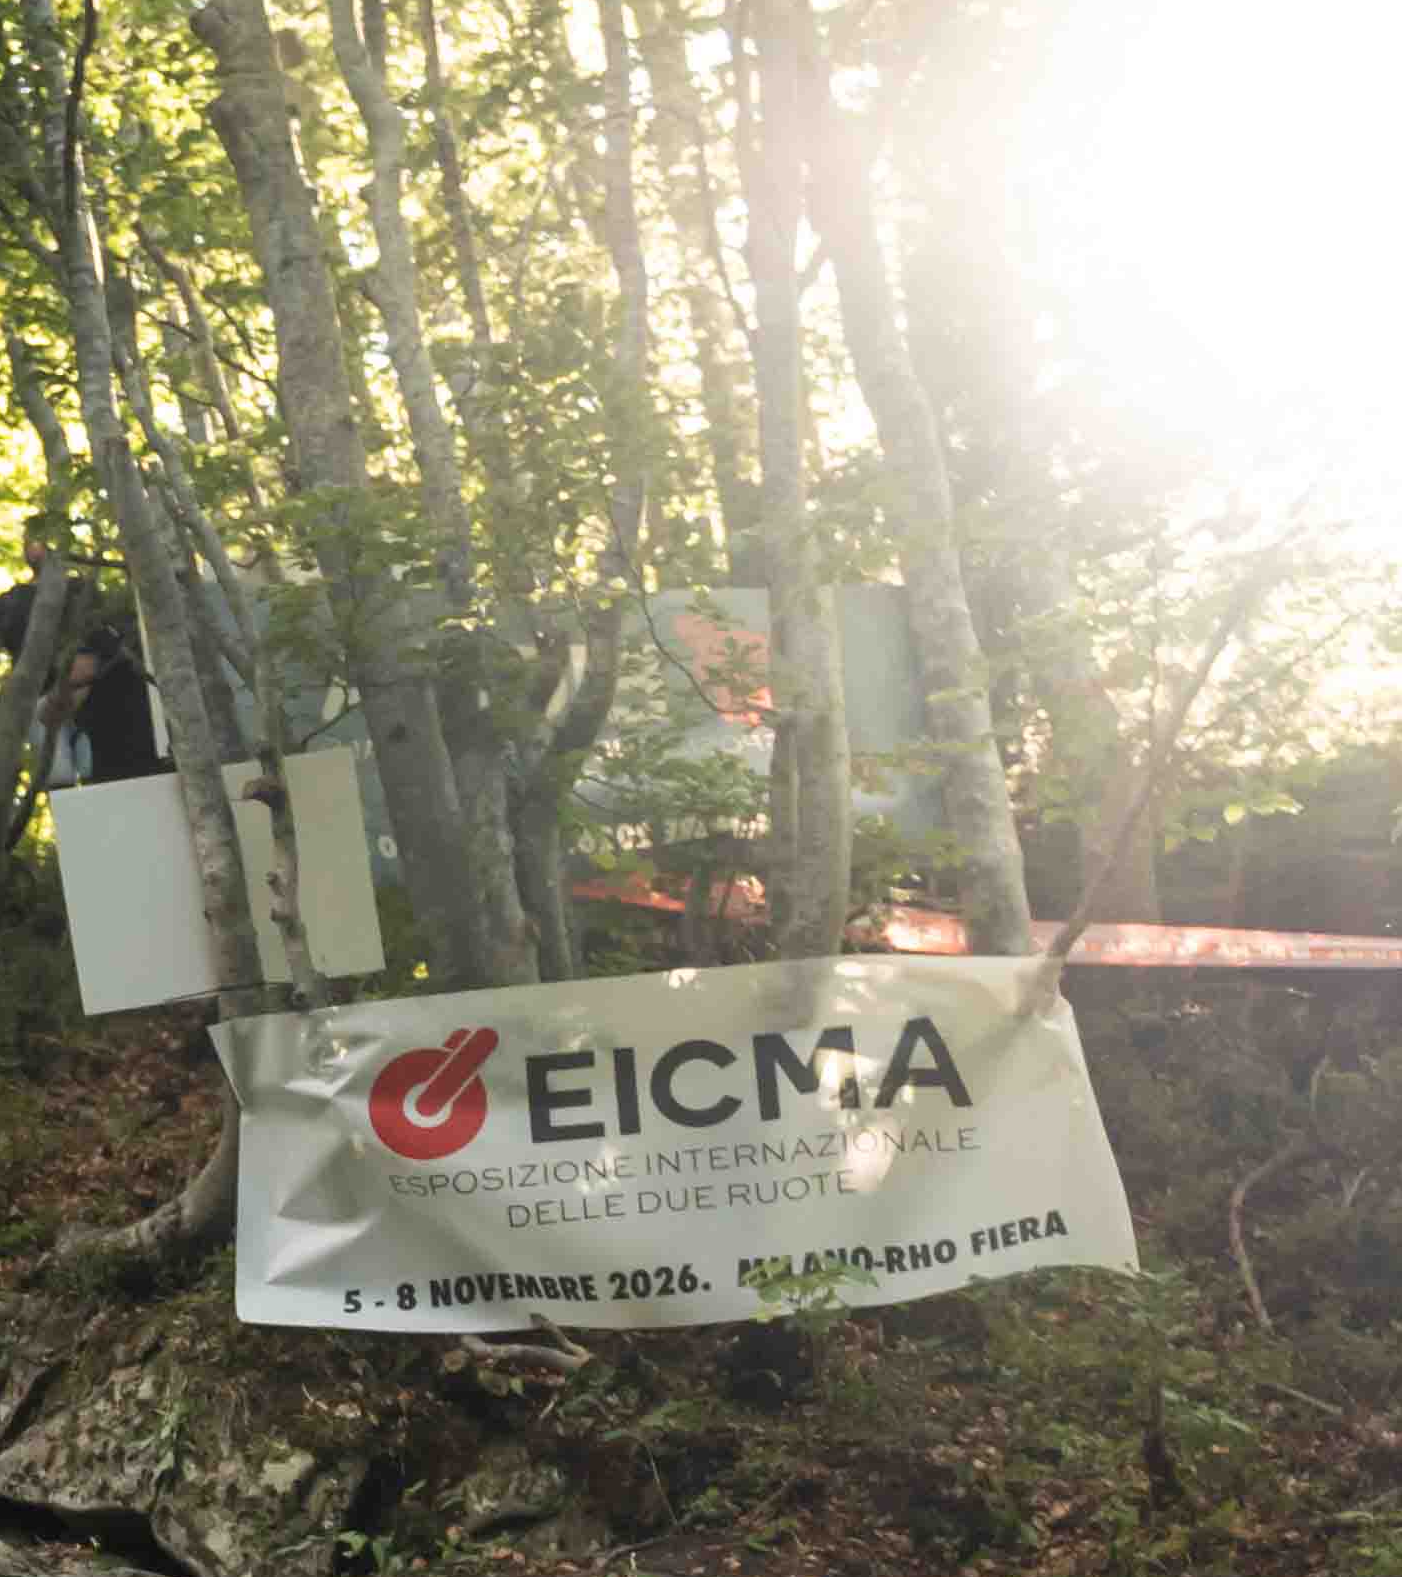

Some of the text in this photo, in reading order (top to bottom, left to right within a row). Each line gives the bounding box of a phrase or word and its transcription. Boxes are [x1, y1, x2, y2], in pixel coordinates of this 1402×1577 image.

[525, 1016, 973, 1143] EICMA
[388, 1127, 982, 1197] ESPOSIZIONE INTERNAZIONALE
[507, 1170, 858, 1228] DELLE DUE RUOTE
[343, 1289, 362, 1313] 5
[397, 1283, 417, 1311] 8
[429, 1272, 598, 1308] NOVEMBRE
[608, 1264, 711, 1301] 2026.
[970, 1209, 1069, 1257] FIERA
